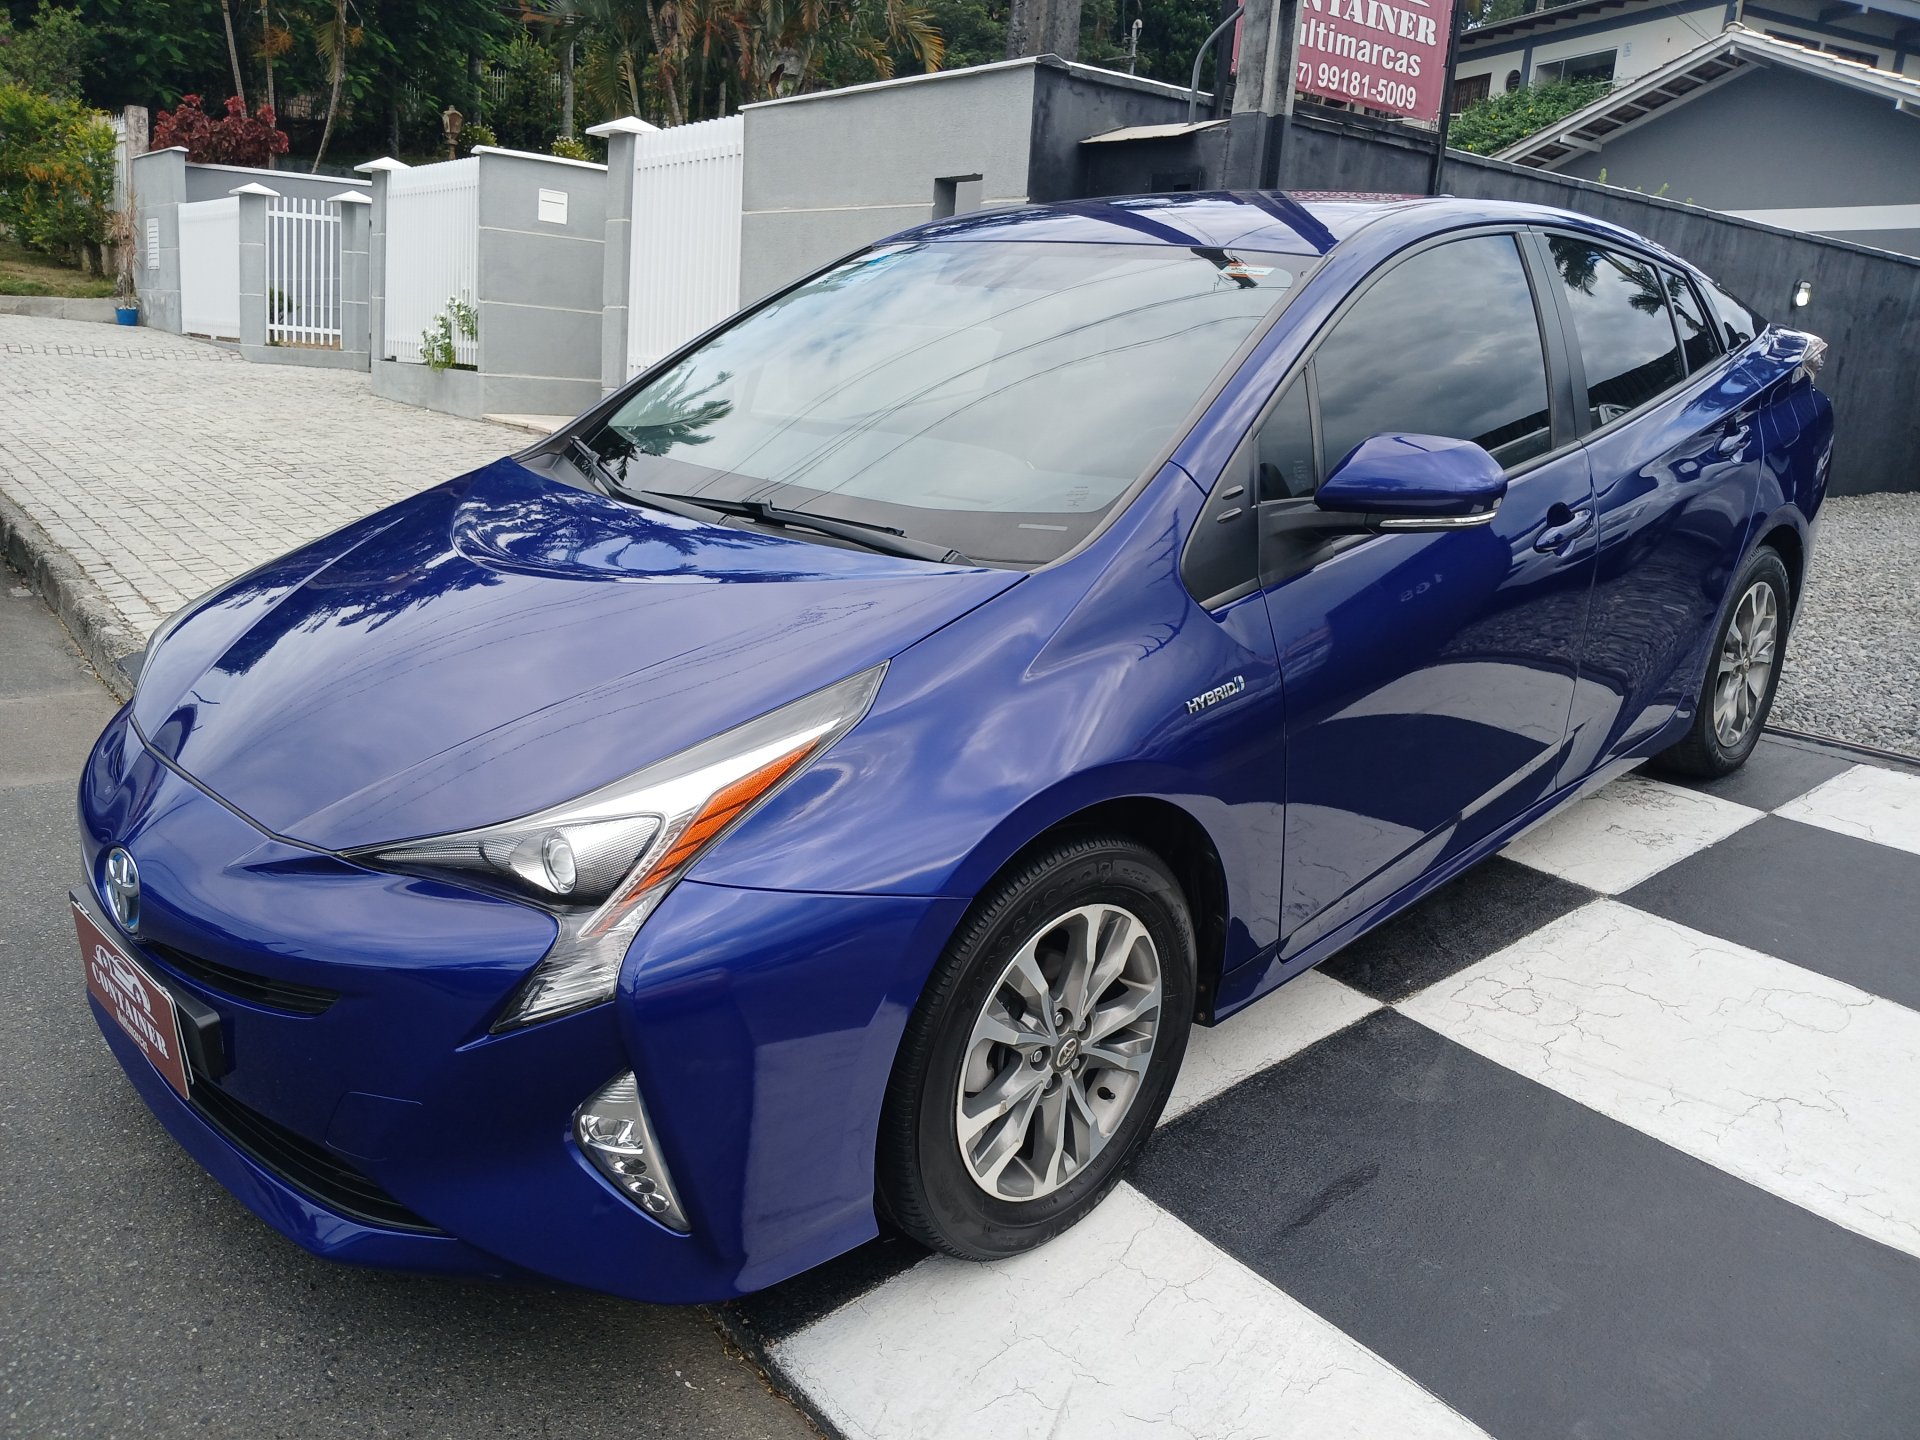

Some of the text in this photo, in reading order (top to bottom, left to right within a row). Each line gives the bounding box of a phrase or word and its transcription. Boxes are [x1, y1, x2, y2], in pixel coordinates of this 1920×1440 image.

[1296, 61, 1417, 110] 7) 99181-5009
[1186, 681, 1238, 714] HYBRID
[92, 961, 169, 1060] CONTAINER
